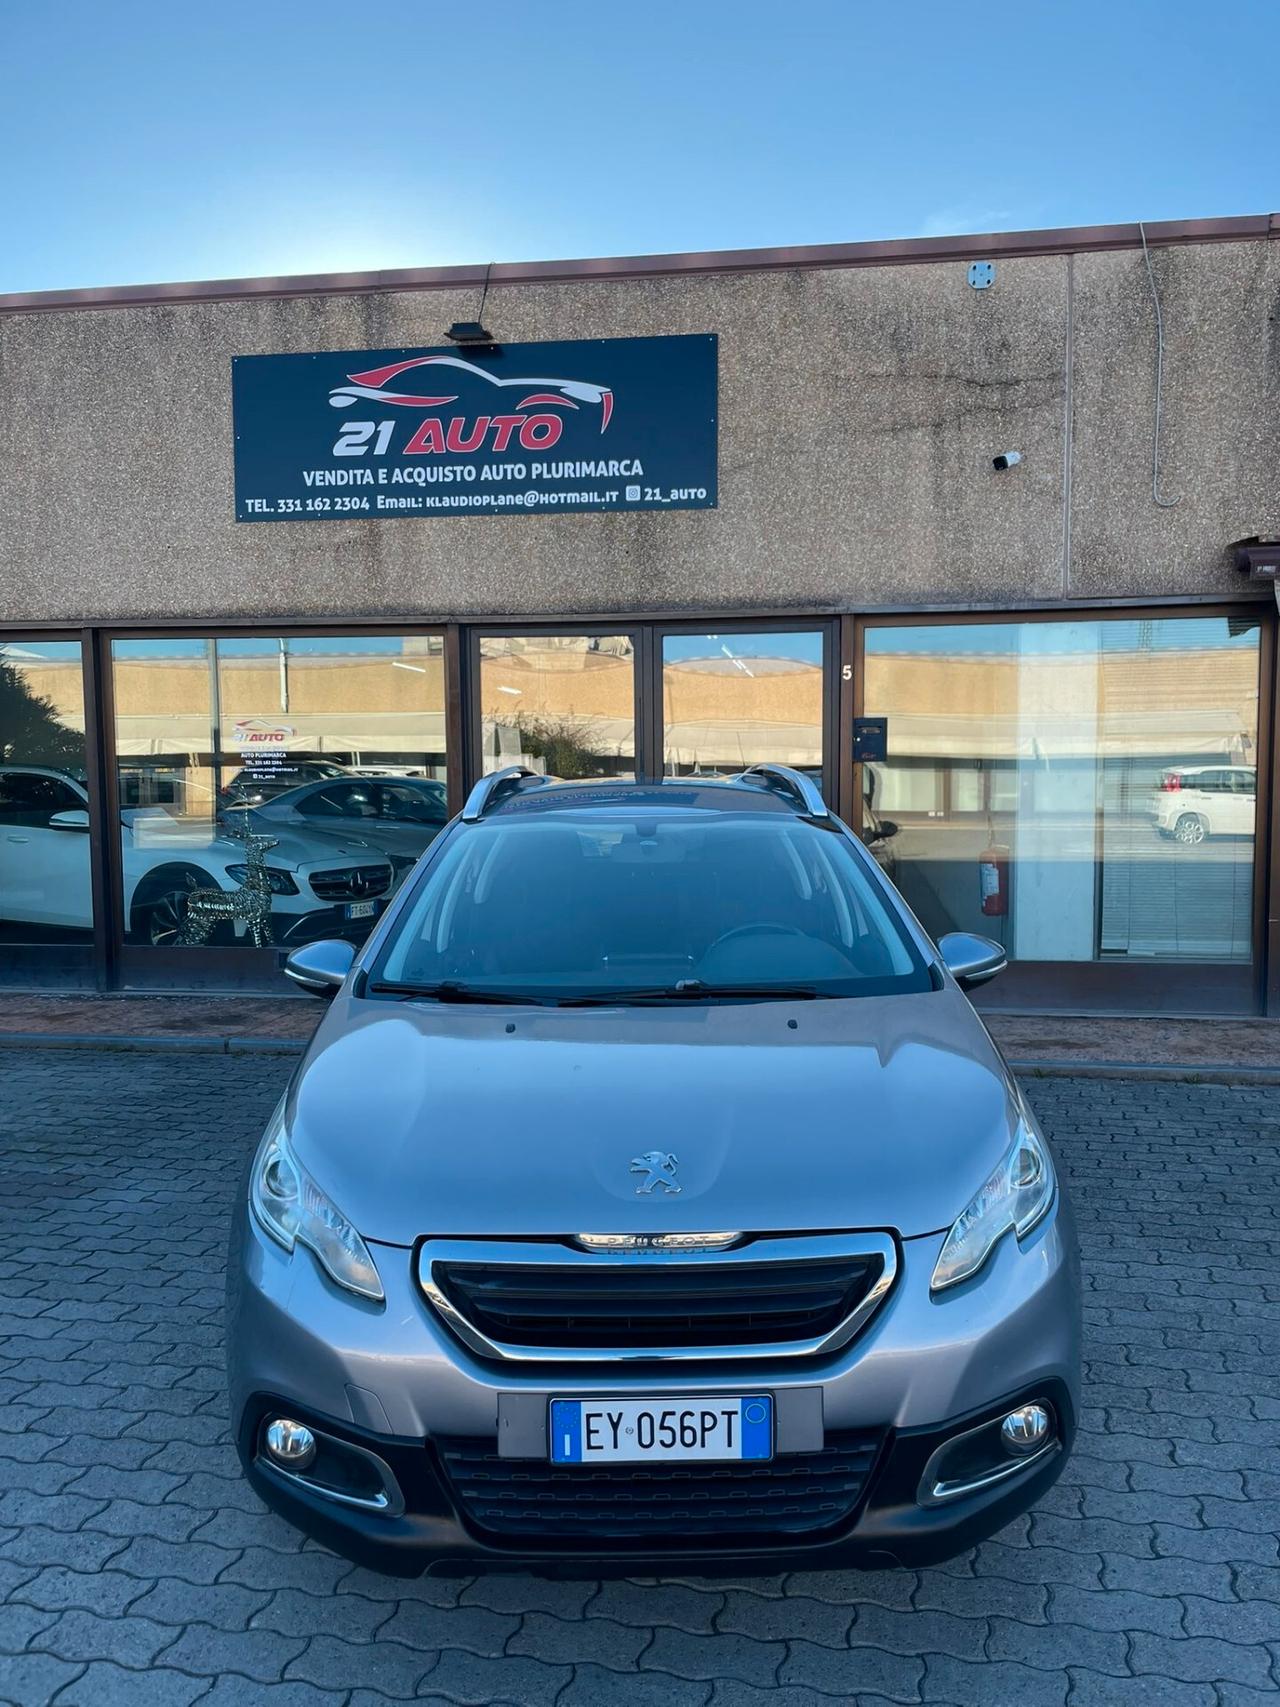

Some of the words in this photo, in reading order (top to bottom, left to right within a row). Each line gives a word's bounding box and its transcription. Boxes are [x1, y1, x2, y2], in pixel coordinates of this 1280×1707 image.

[333, 420, 396, 457] 21
[402, 414, 563, 455] AUTO
[302, 469, 375, 487] VENDITA
[378, 468, 388, 485] E
[391, 465, 477, 487] ACQUISTO
[480, 463, 527, 482] AUTO
[531, 459, 644, 480] PLURIMARCA
[245, 499, 275, 513] TEL.
[277, 498, 303, 512] 331
[306, 497, 331, 511] 162
[334, 496, 370, 511] 2304
[842, 664, 853, 680] 5
[249, 733, 285, 742] AUTO
[607, 1236, 710, 1247] PEUGEOT
[585, 1412, 624, 1450] EY
[636, 1410, 739, 1450] 056PT
